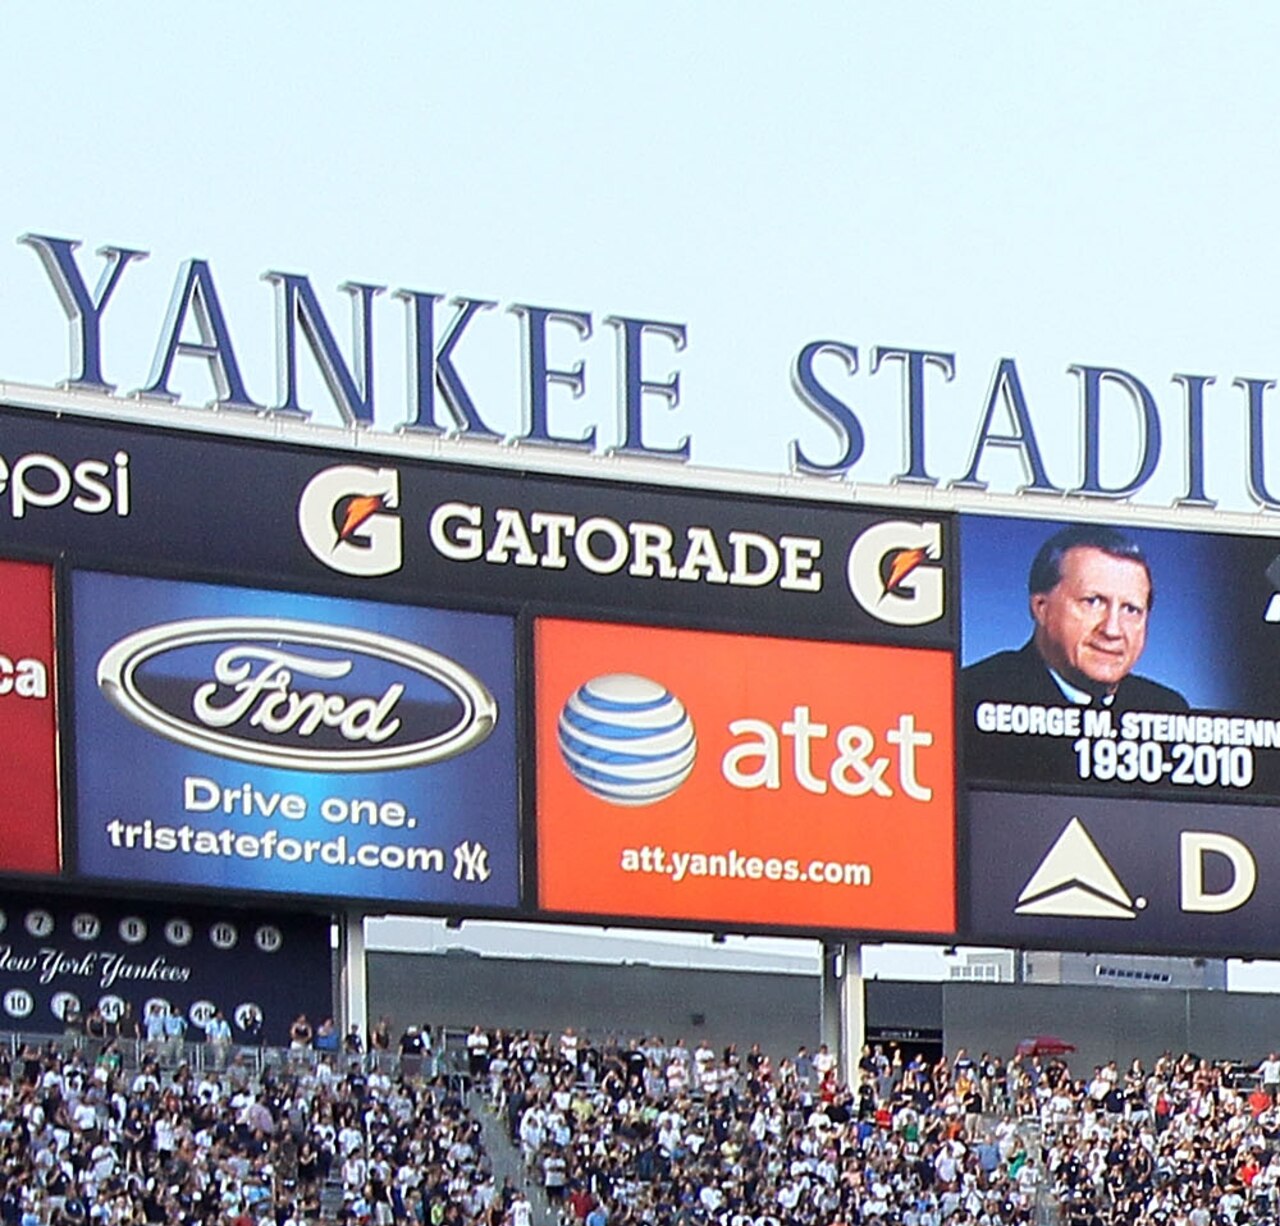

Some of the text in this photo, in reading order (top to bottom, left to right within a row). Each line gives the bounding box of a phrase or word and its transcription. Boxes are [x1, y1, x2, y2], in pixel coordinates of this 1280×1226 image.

[17, 232, 691, 462] YANKEE
[0, 450, 130, 518] psi
[299, 463, 945, 625] G GATORADE G
[193, 646, 404, 742] Ford
[976, 703, 1081, 737] GEORGE
[1084, 709, 1117, 739] M.
[720, 705, 934, 802] at&t
[1074, 738, 1254, 788] 1930-2010
[184, 777, 417, 828] Drive one.
[107, 819, 444, 873] tristateford.com
[620, 846, 871, 887] att.yankees.com
[38, 947, 98, 984] York
[99, 950, 192, 988] Yankees
